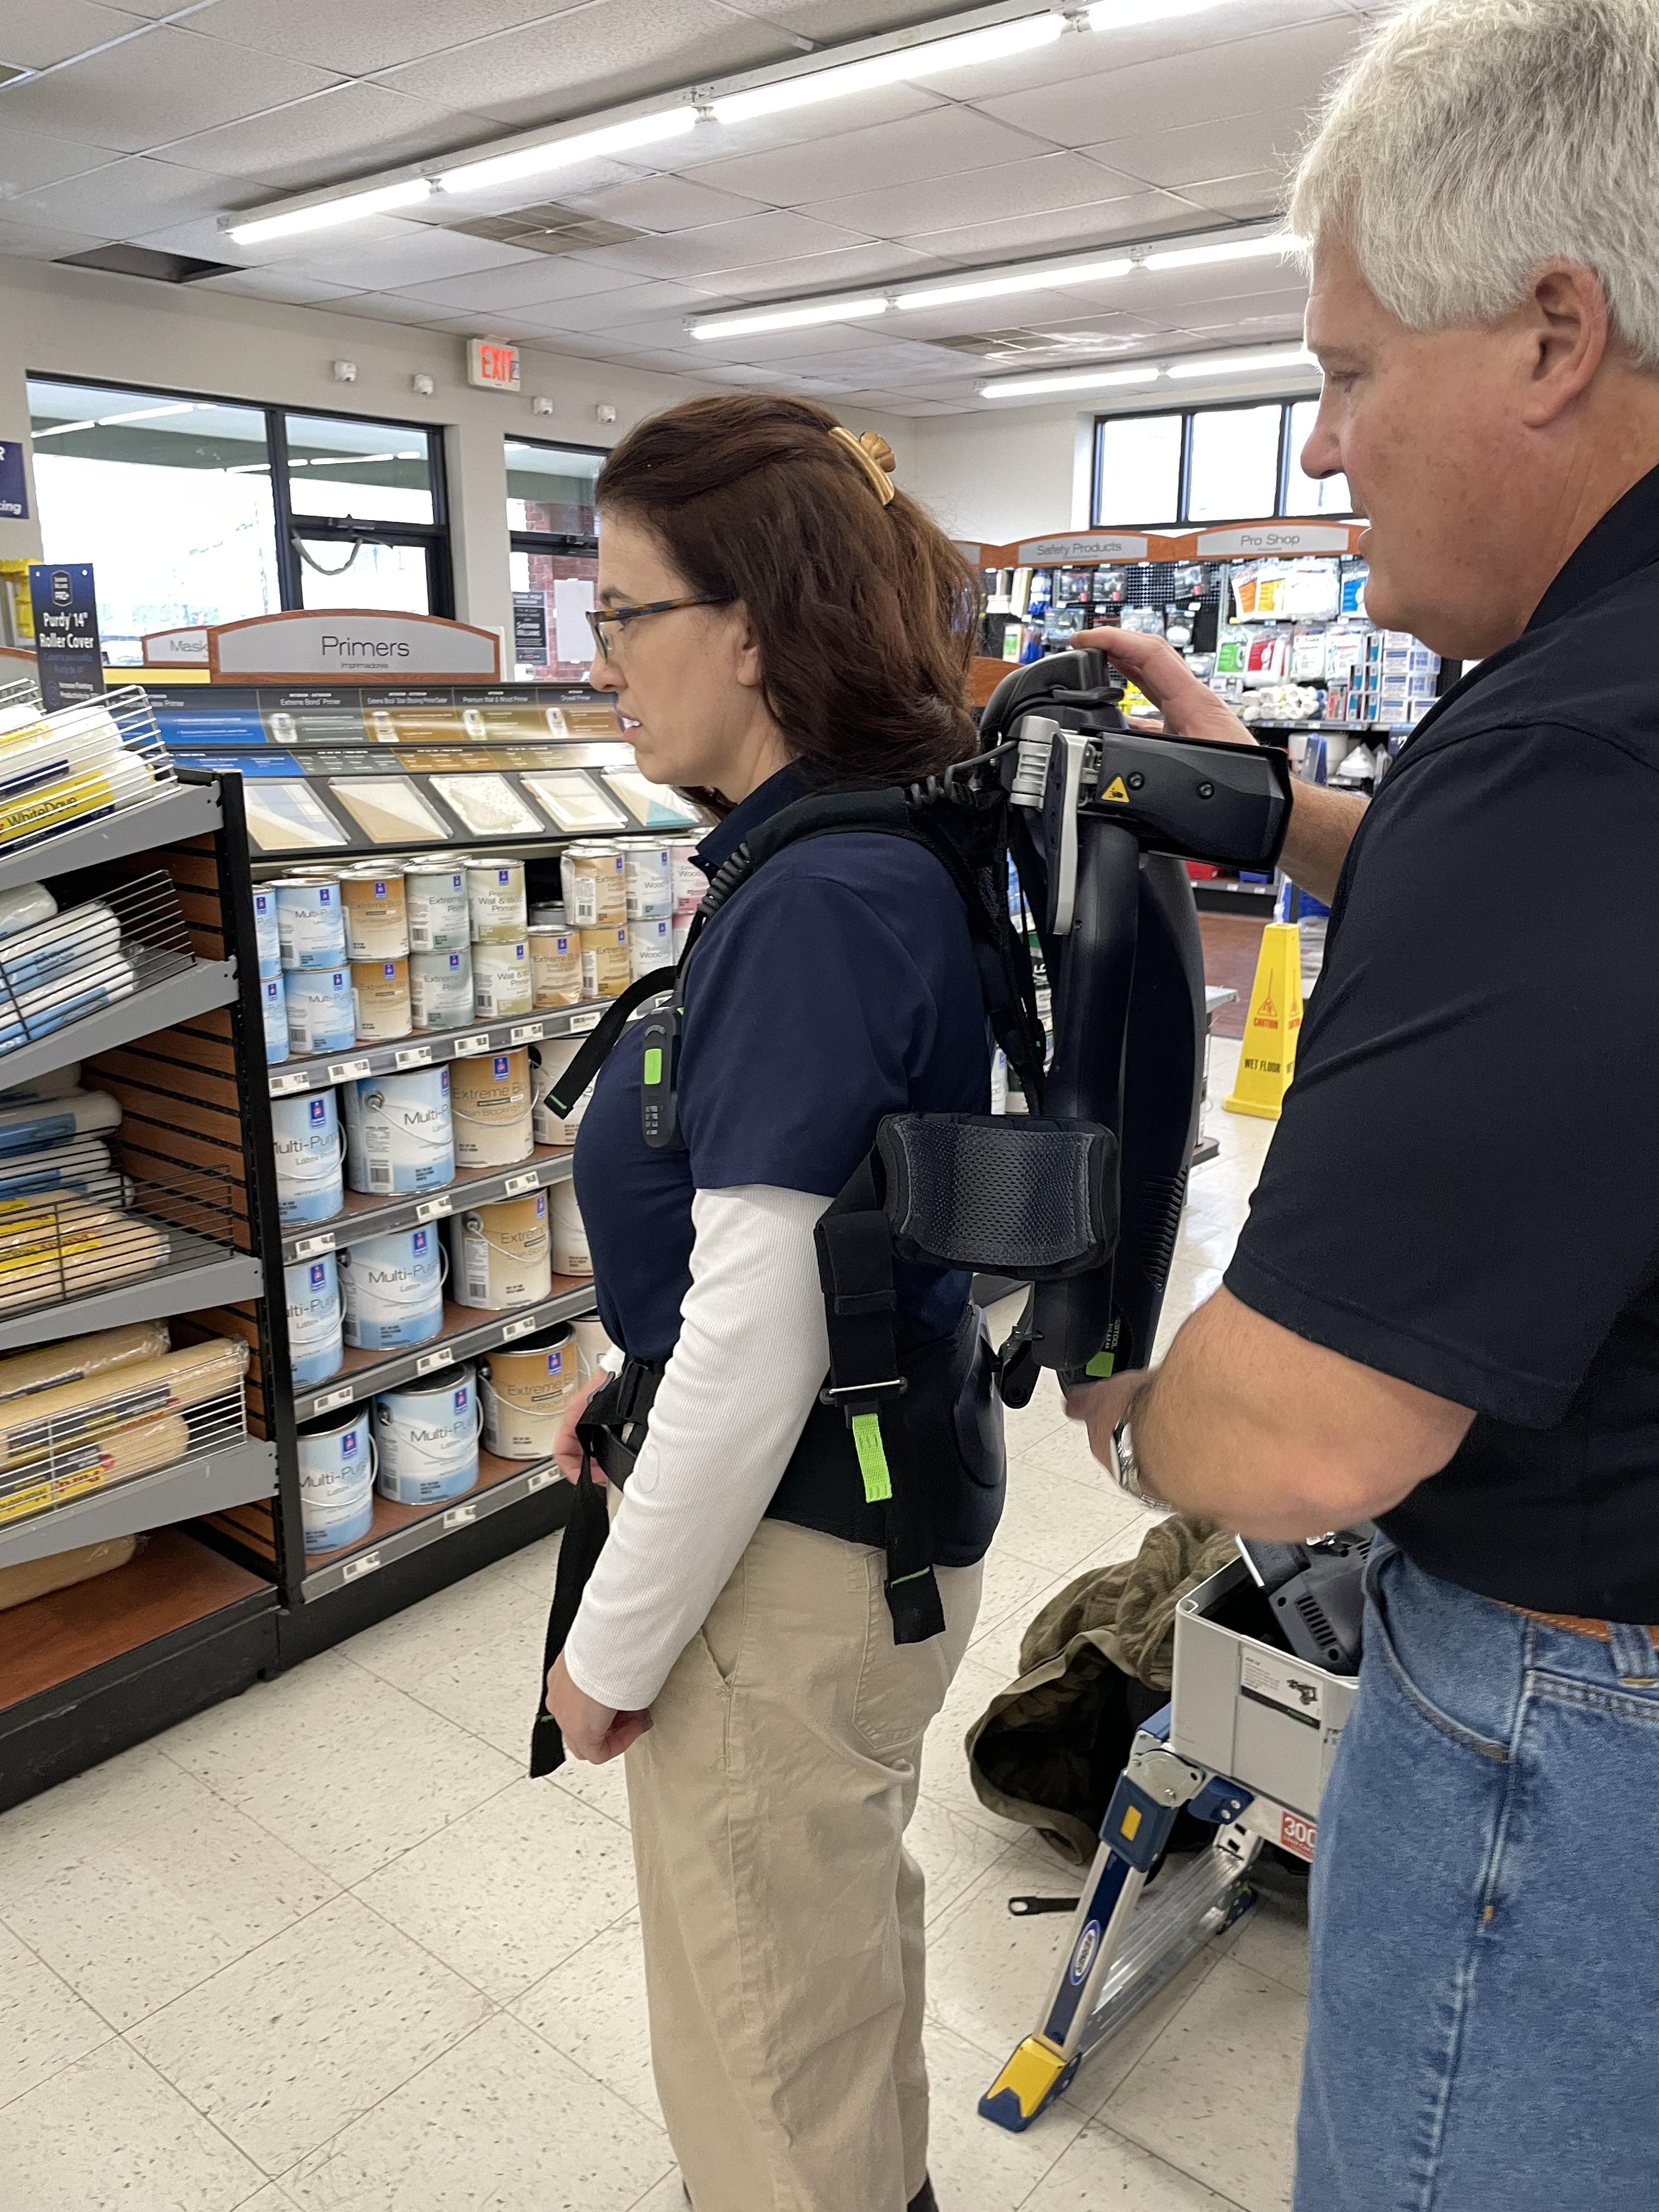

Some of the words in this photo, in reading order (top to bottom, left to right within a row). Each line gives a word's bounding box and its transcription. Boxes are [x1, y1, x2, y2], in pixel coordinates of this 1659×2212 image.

[481, 345, 514, 382] EXIT
[0, 500, 22, 515] ing
[1240, 535, 1263, 546] Pro
[1266, 534, 1301, 546] Shop
[1036, 544, 1069, 556] Safety
[1072, 541, 1122, 554] Products
[66, 633, 94, 648] Cover
[321, 636, 410, 657] Primers
[451, 1086, 510, 1100] Extreme
[507, 1380, 563, 1397] Extreme
